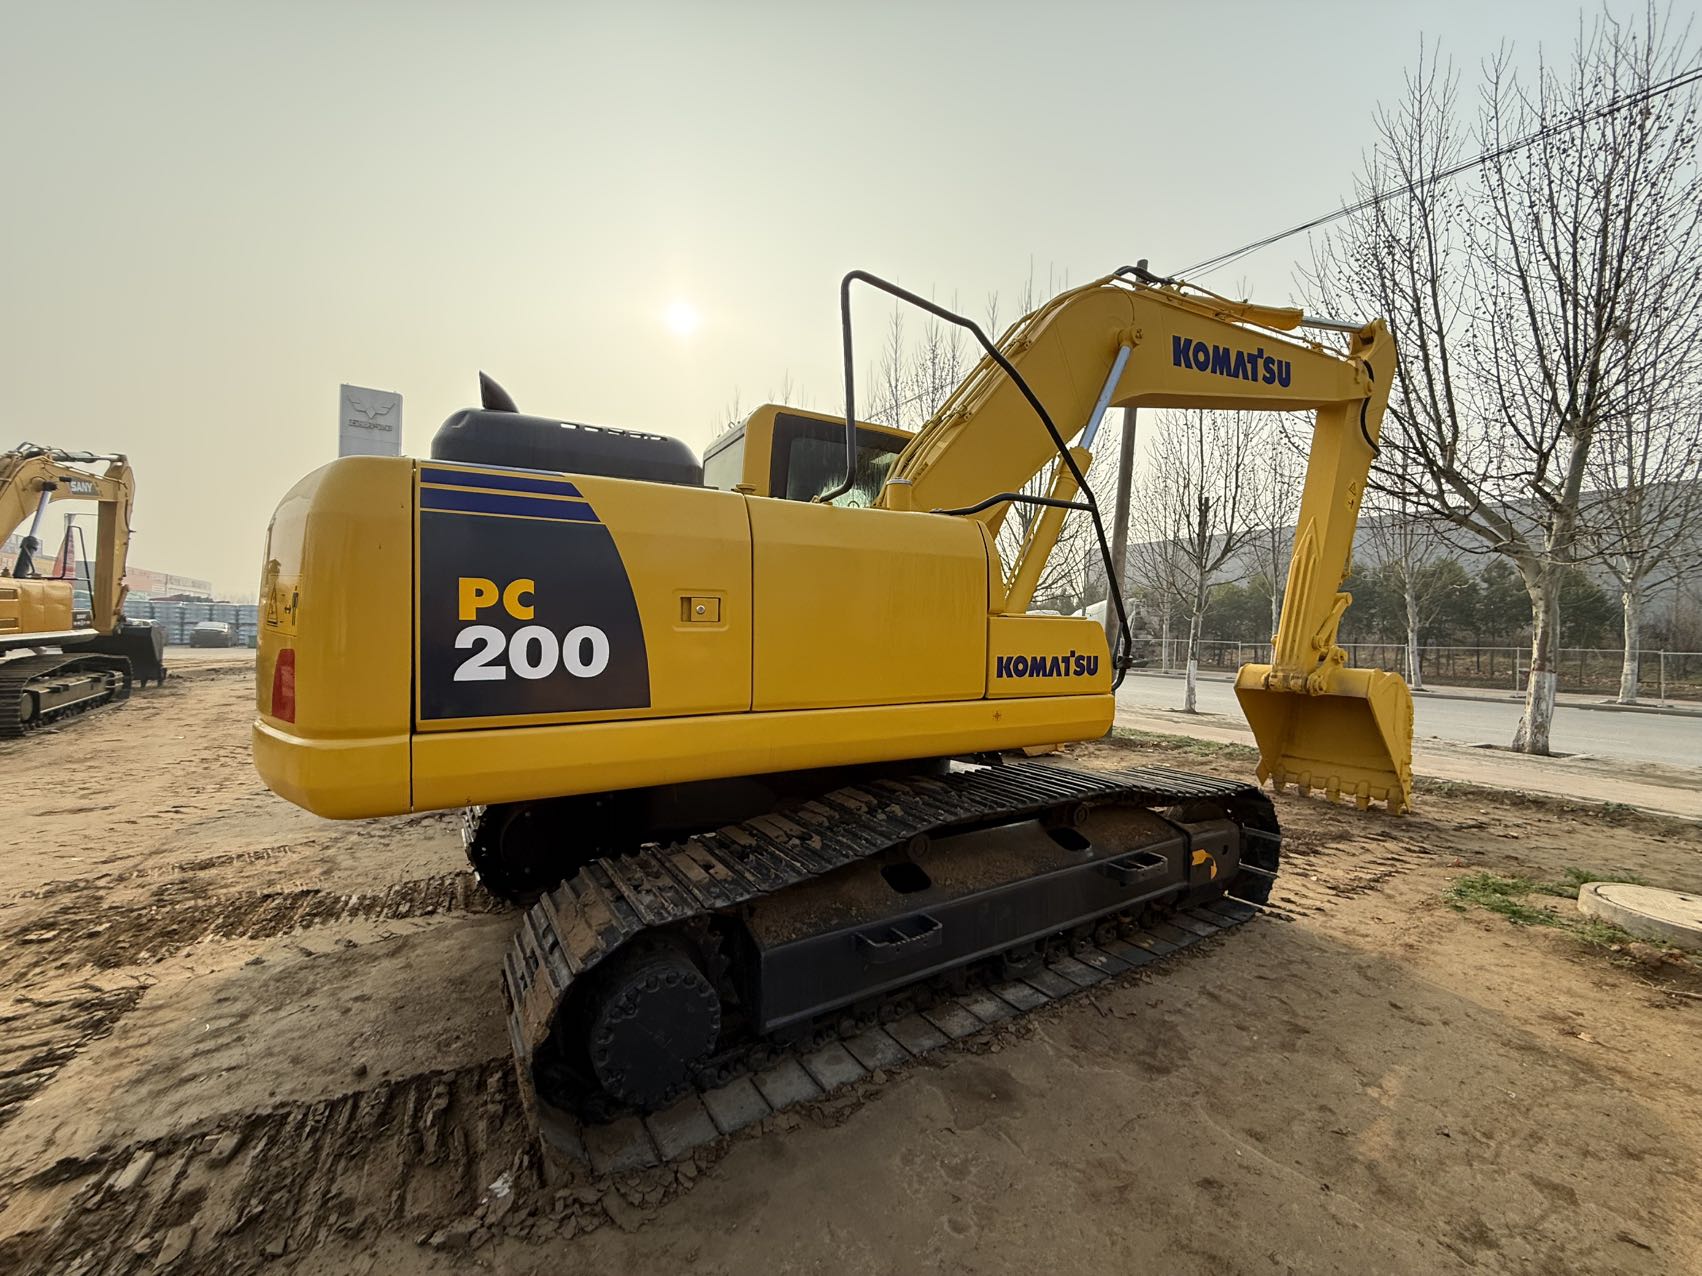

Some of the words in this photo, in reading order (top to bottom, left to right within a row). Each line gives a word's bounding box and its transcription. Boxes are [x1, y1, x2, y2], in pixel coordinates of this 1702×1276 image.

[1172, 335, 1291, 388] KOMATSU
[70, 481, 93, 493] SANY
[458, 577, 535, 621] PC
[453, 625, 610, 682] 200
[996, 650, 1099, 678] KOMATSU
